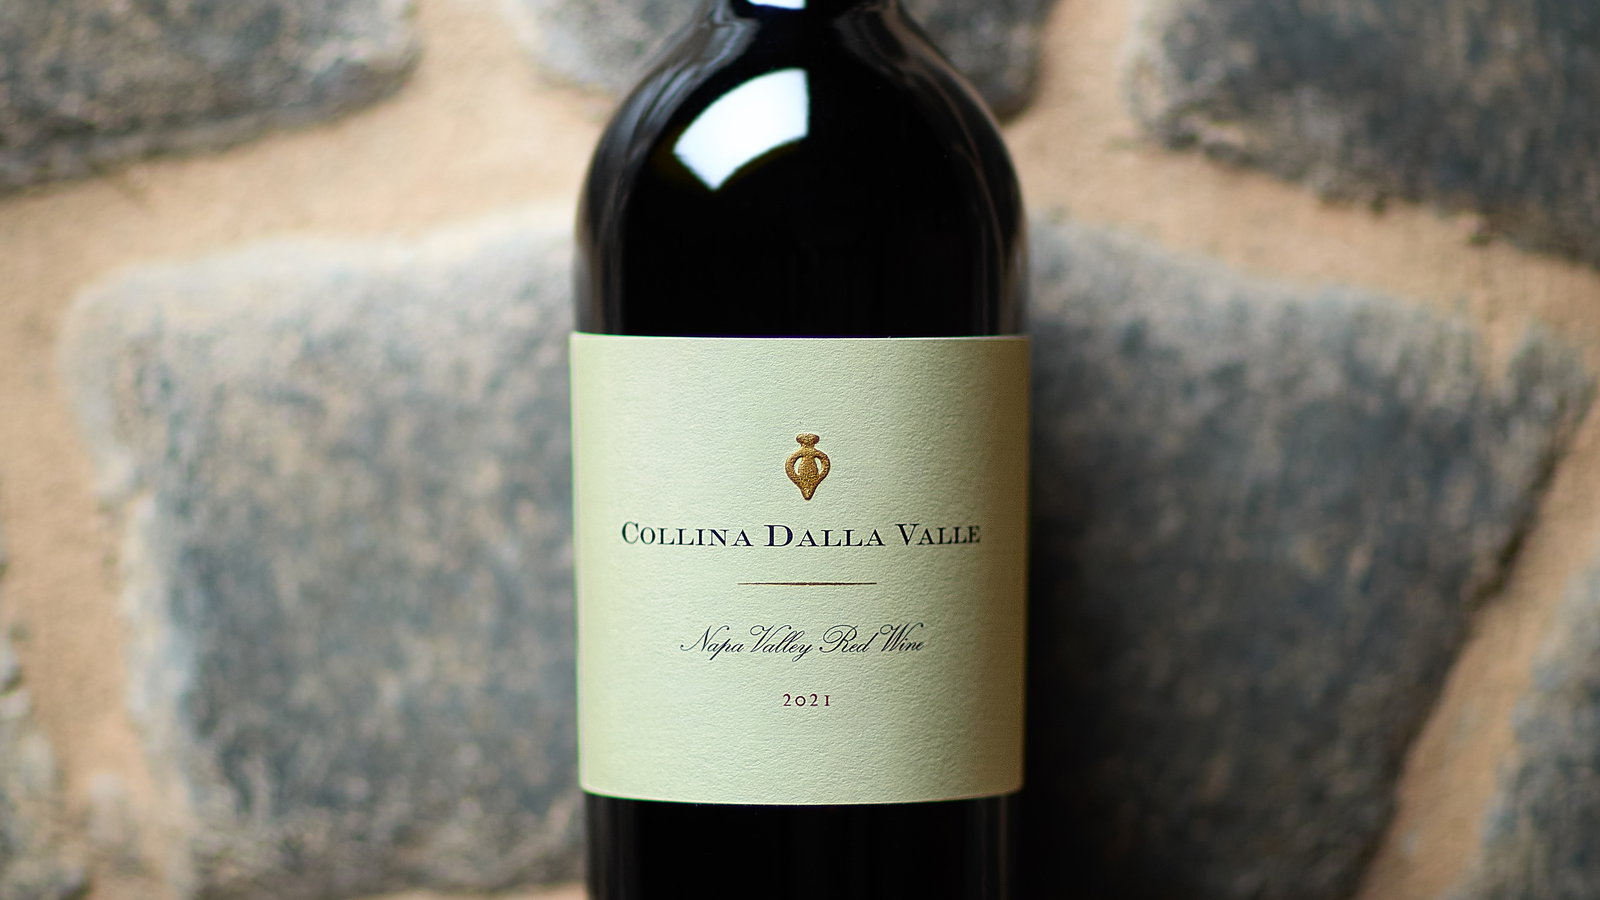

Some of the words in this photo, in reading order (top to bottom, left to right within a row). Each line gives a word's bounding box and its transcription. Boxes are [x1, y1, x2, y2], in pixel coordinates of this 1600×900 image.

[621, 521, 754, 547] COLLINA
[764, 524, 886, 547] DALLA
[895, 523, 981, 545] VALLE
[680, 624, 745, 661] Napa
[749, 624, 813, 662] Valley
[819, 624, 879, 653] Red
[879, 622, 925, 653] Wine
[783, 693, 831, 707] 2021
